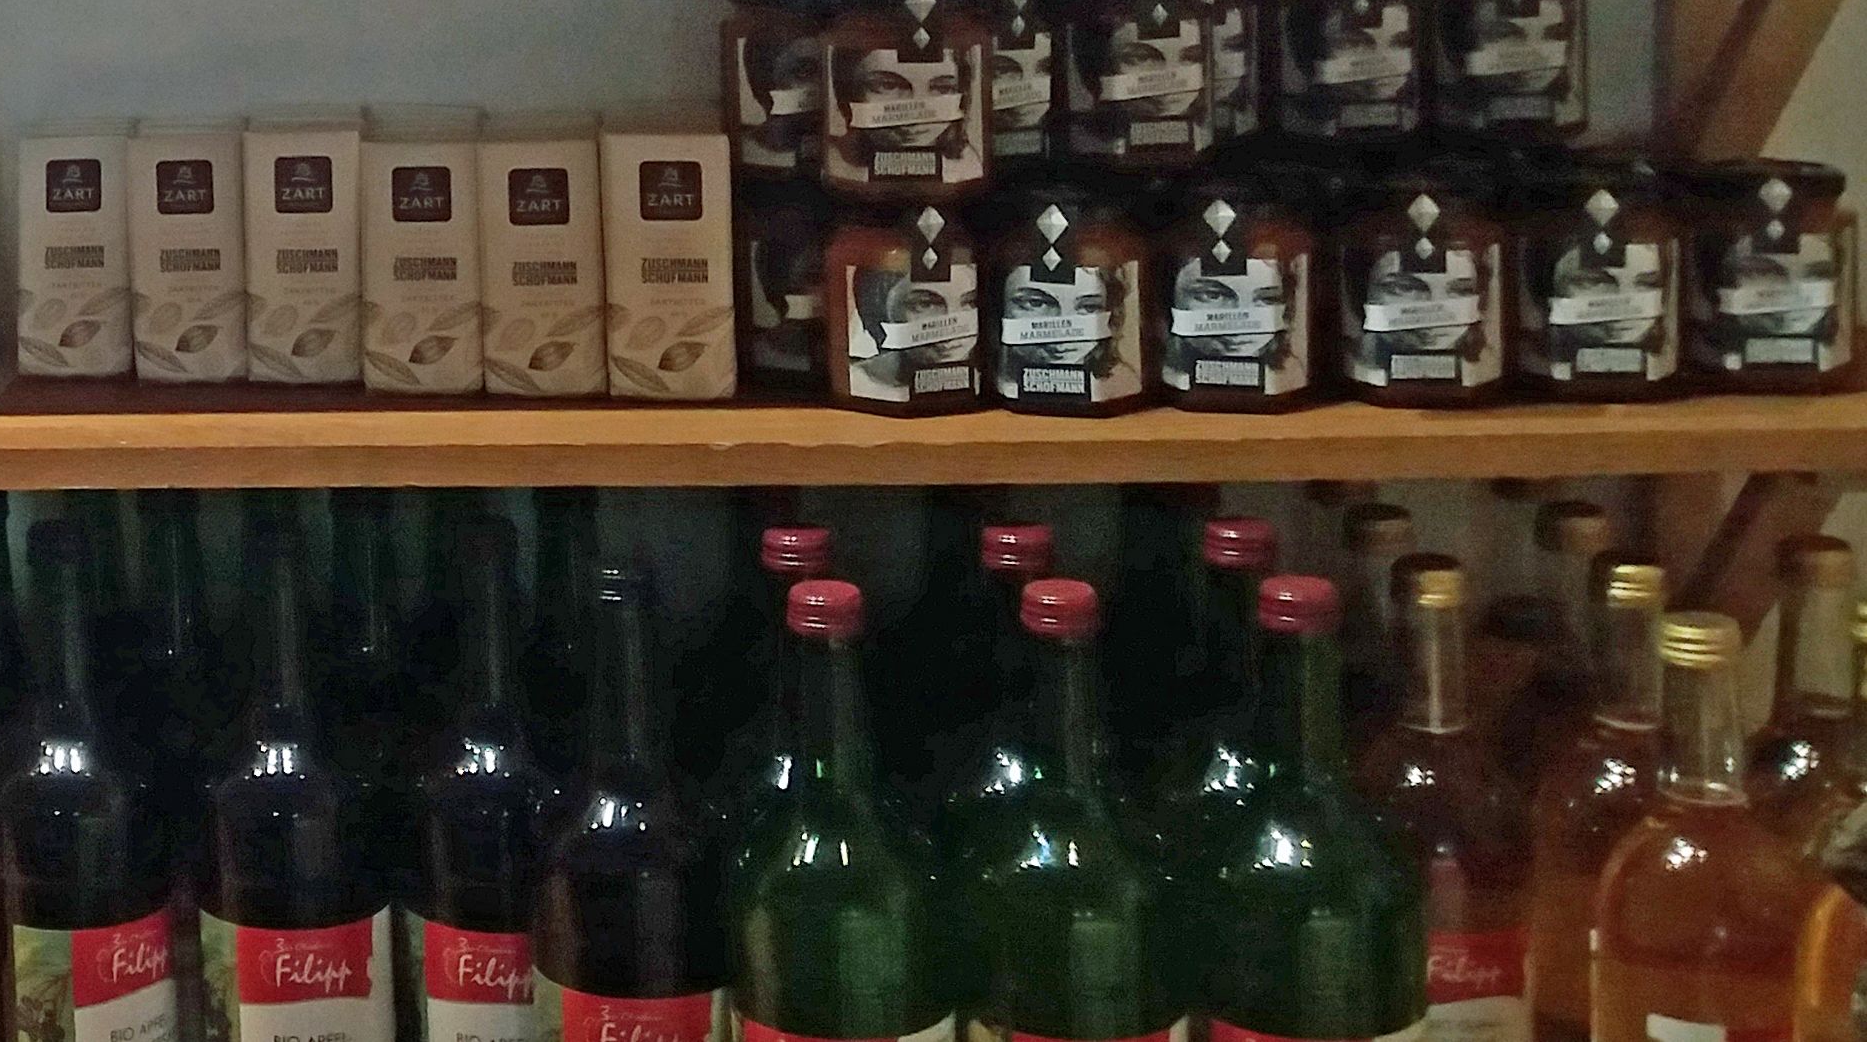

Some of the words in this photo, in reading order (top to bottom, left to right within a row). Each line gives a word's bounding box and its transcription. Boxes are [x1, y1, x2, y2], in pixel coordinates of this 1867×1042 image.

[52, 187, 94, 201] ZART
[164, 189, 206, 203] ZART
[282, 187, 324, 200] ZART
[648, 194, 693, 207] ZART
[398, 197, 444, 210] ZART
[516, 199, 561, 213] ZART
[275, 953, 353, 994] Filipp
